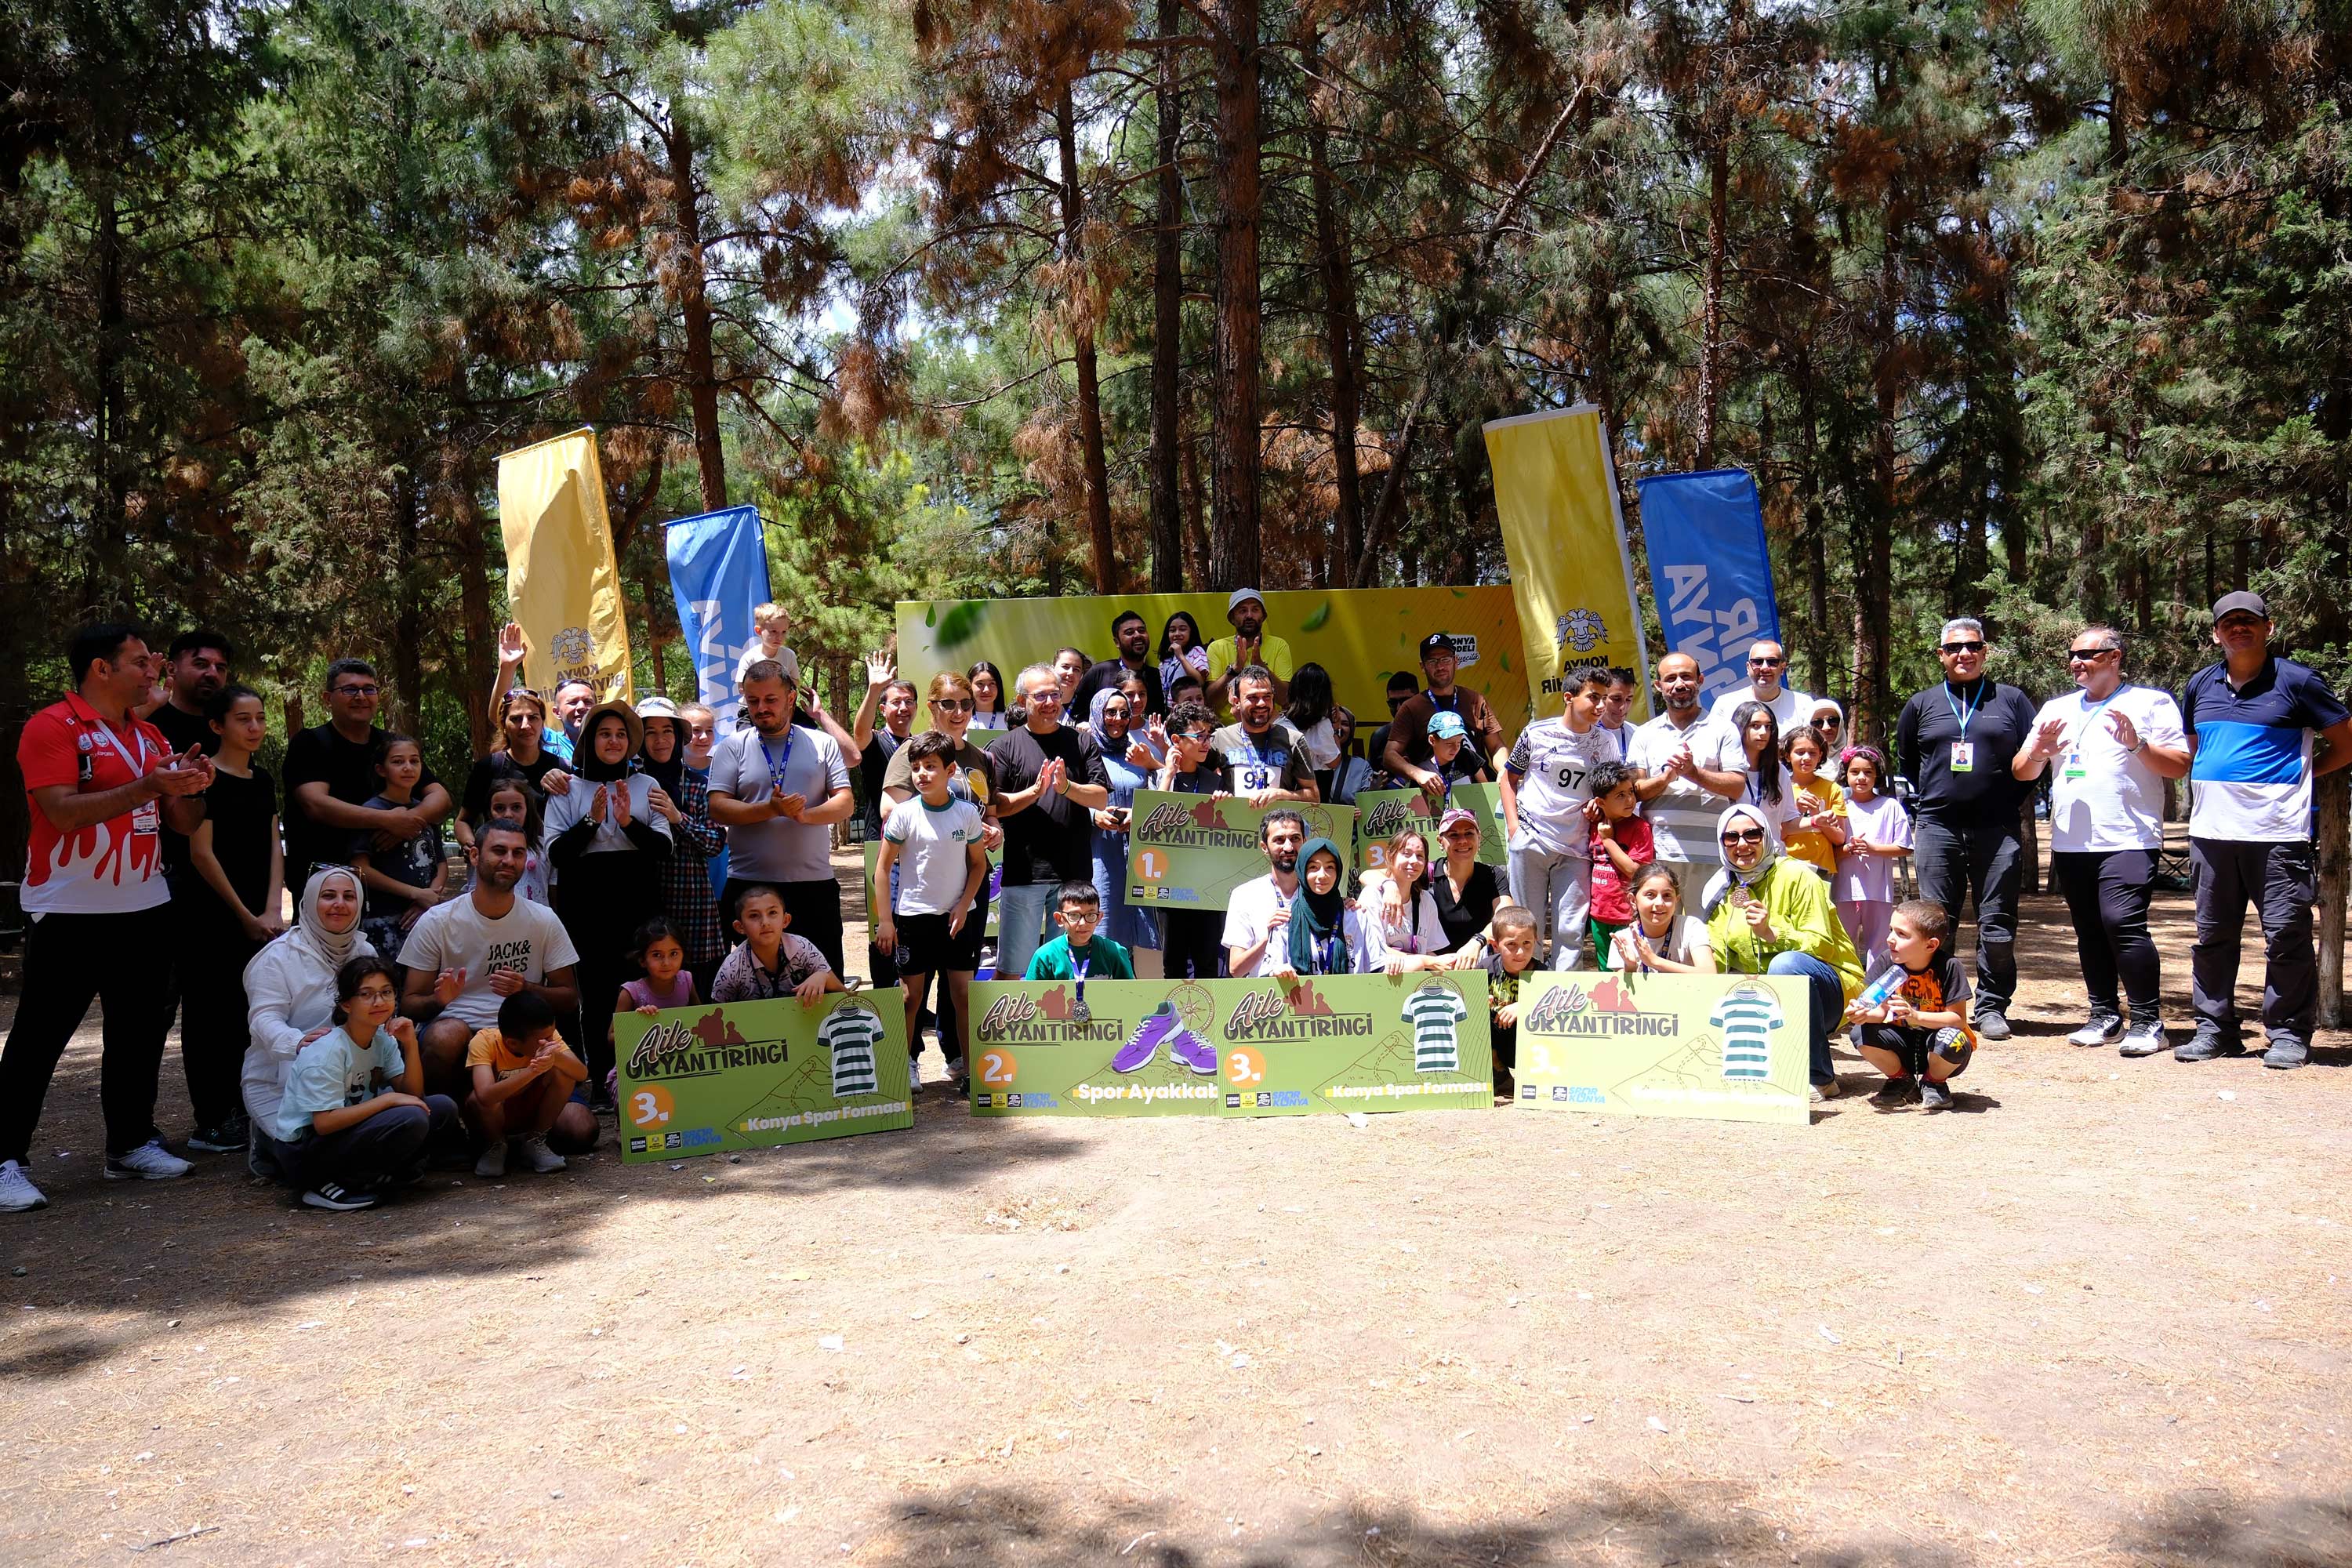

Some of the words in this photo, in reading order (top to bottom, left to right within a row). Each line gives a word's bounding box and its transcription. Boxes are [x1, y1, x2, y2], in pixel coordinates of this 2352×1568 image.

[1558, 768, 1586, 789] 97
[1142, 800, 1191, 833] Aile
[1367, 797, 1407, 829] Aile
[1142, 853, 1162, 879] 1.
[981, 991, 1036, 1033] Aile
[1229, 987, 1284, 1032] Aile
[1530, 983, 1587, 1022] Aile
[632, 1019, 693, 1067] Aile
[984, 1054, 1012, 1082] 2.
[1232, 1054, 1261, 1082] 3.
[1078, 1083, 1125, 1104] Spor
[1131, 1083, 1218, 1104] Ayakkab
[1333, 1084, 1382, 1100] Konya
[1385, 1083, 1421, 1098] Spor
[1424, 1080, 1487, 1094] Forması
[634, 1092, 669, 1124] 3.
[748, 1113, 801, 1131] Konya
[804, 1109, 840, 1127] Spor
[842, 1102, 907, 1119] Forması
